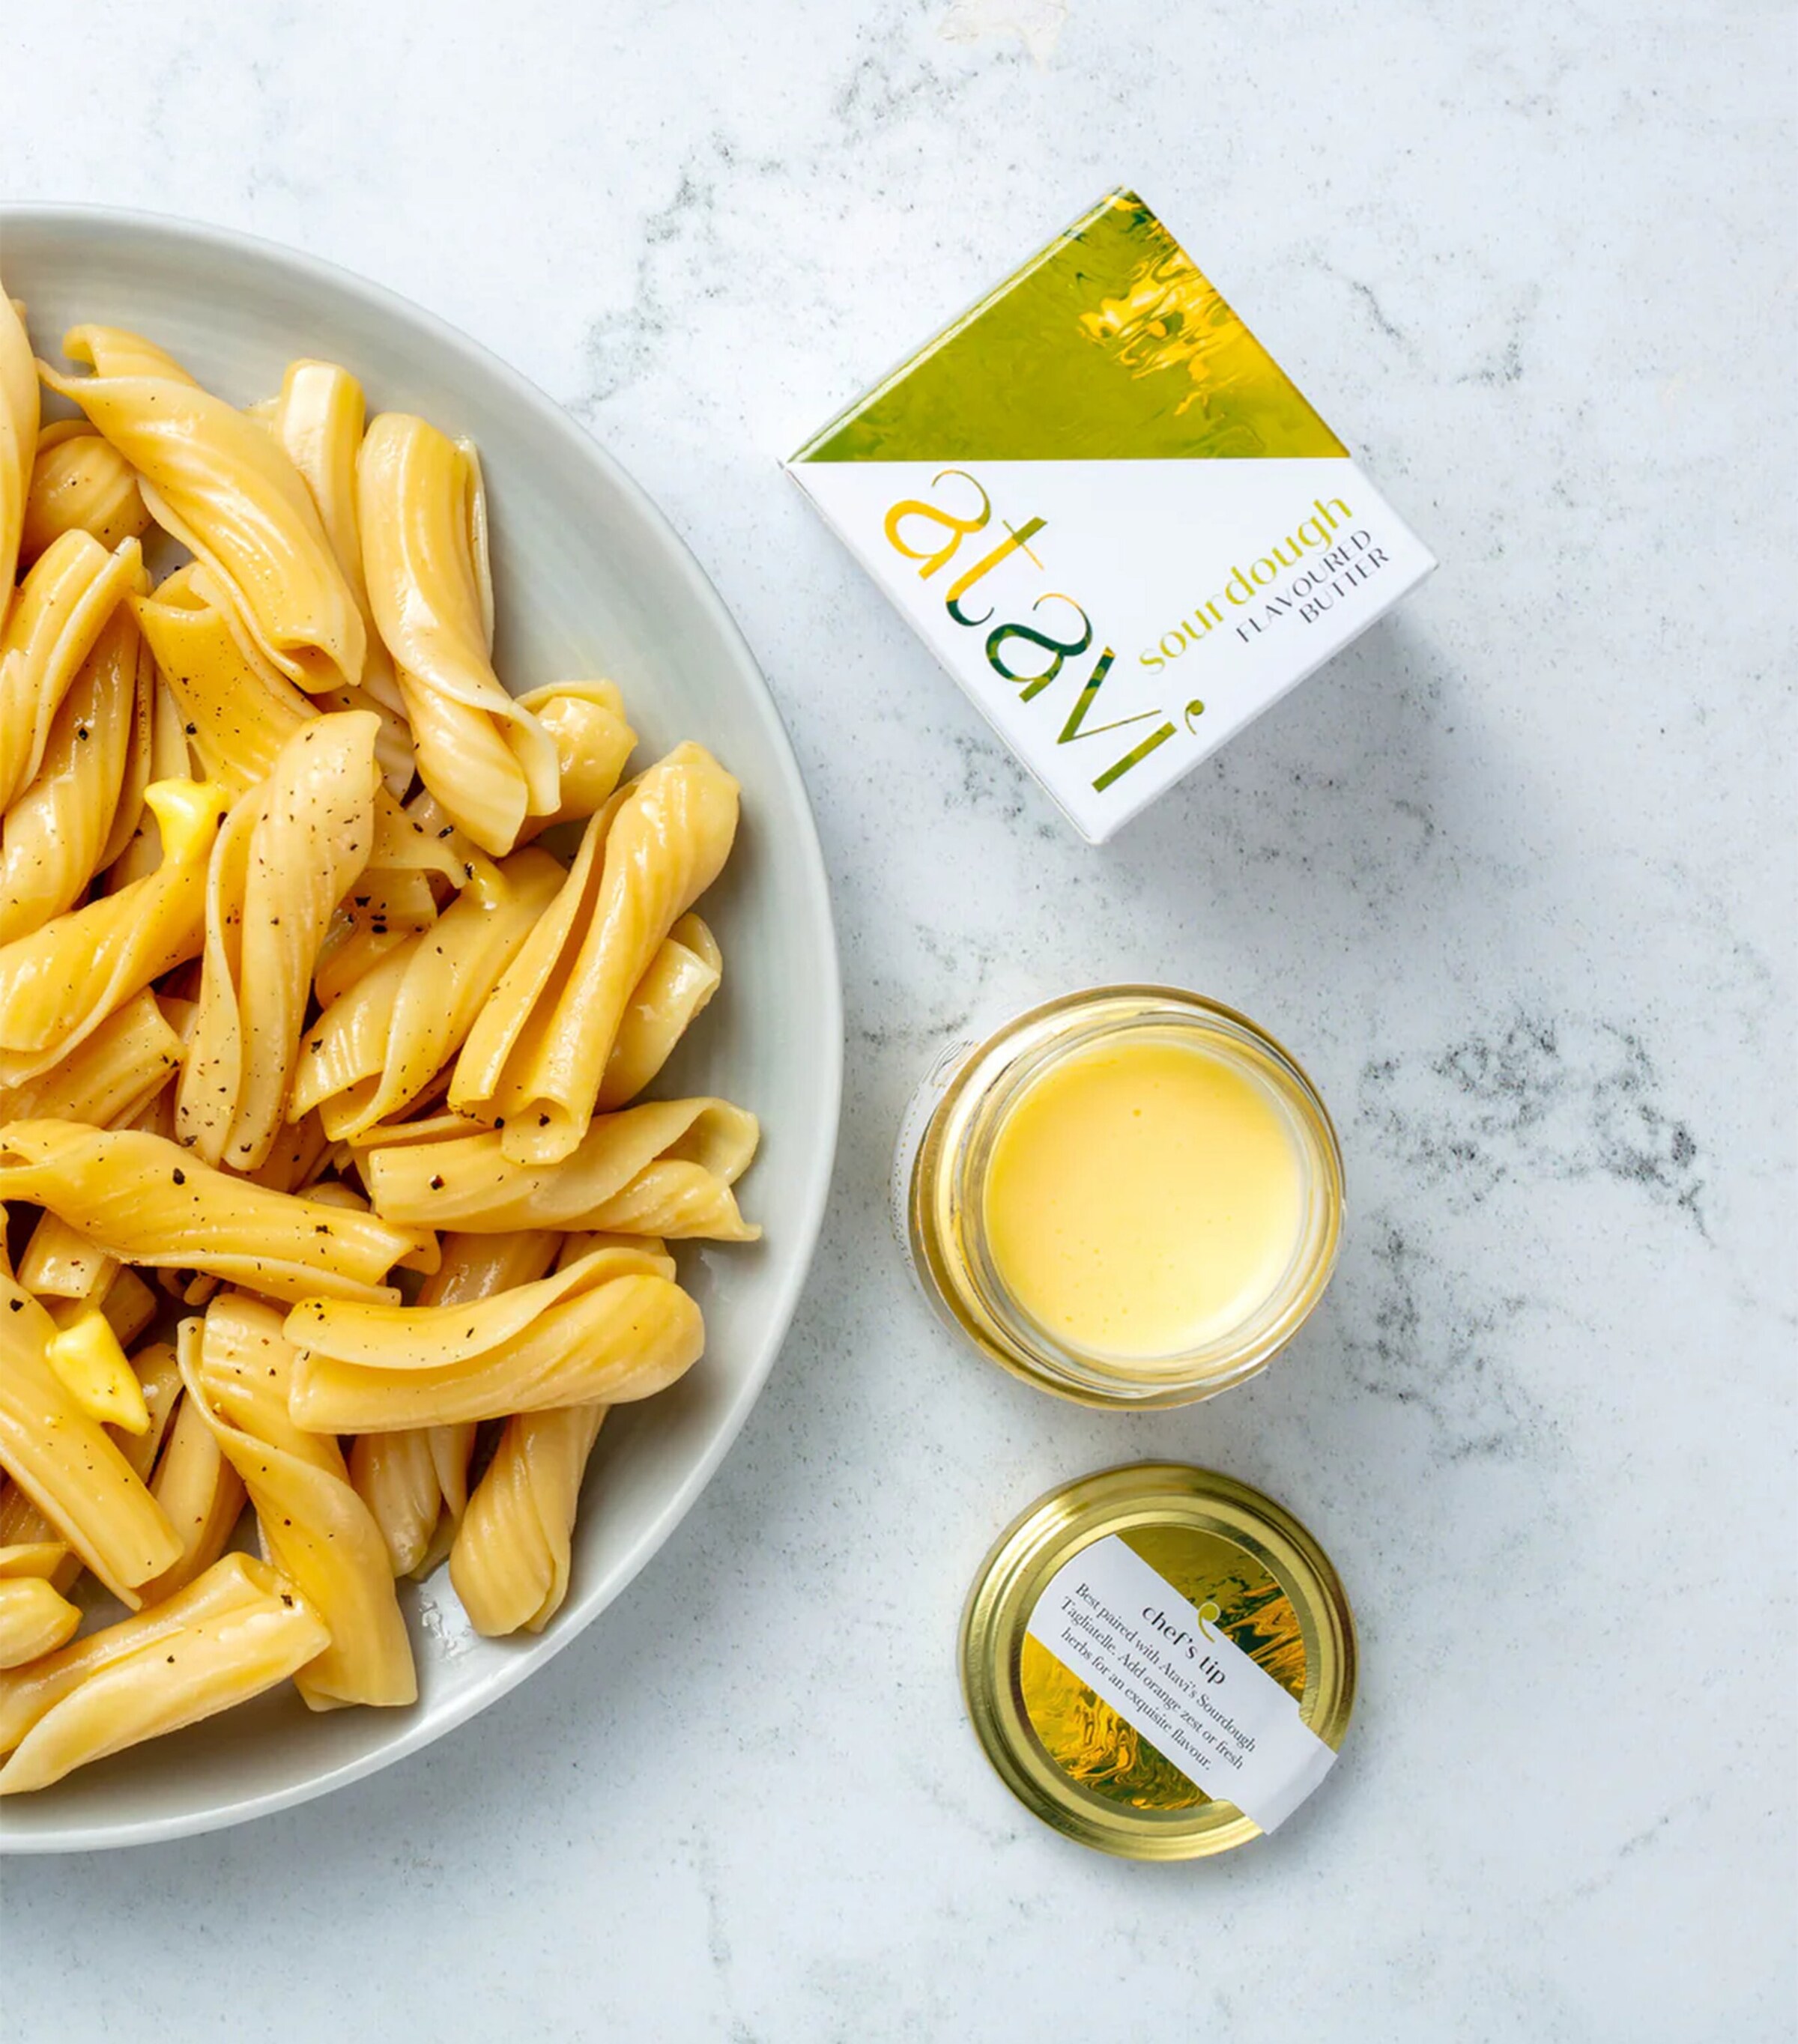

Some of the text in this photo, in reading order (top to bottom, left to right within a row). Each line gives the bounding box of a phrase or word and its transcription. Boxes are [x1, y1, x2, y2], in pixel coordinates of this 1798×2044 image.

[1139, 497, 1353, 676] sourdough
[1235, 529, 1372, 643] FLAVOURED
[1298, 547, 1390, 624] BUTTER
[1061, 1596, 1244, 1770] Tagliatelle. Add orange zest or fresh
[1061, 1627, 1211, 1770] herbs for an exquisite flavour.
[1075, 1583, 1100, 1610] Best
[1095, 1607, 1138, 1643] paired
[1135, 1640, 1160, 1664] with
[1196, 1693, 1256, 1752] Sourdough
[1142, 1607, 1226, 1684] chef's tip
